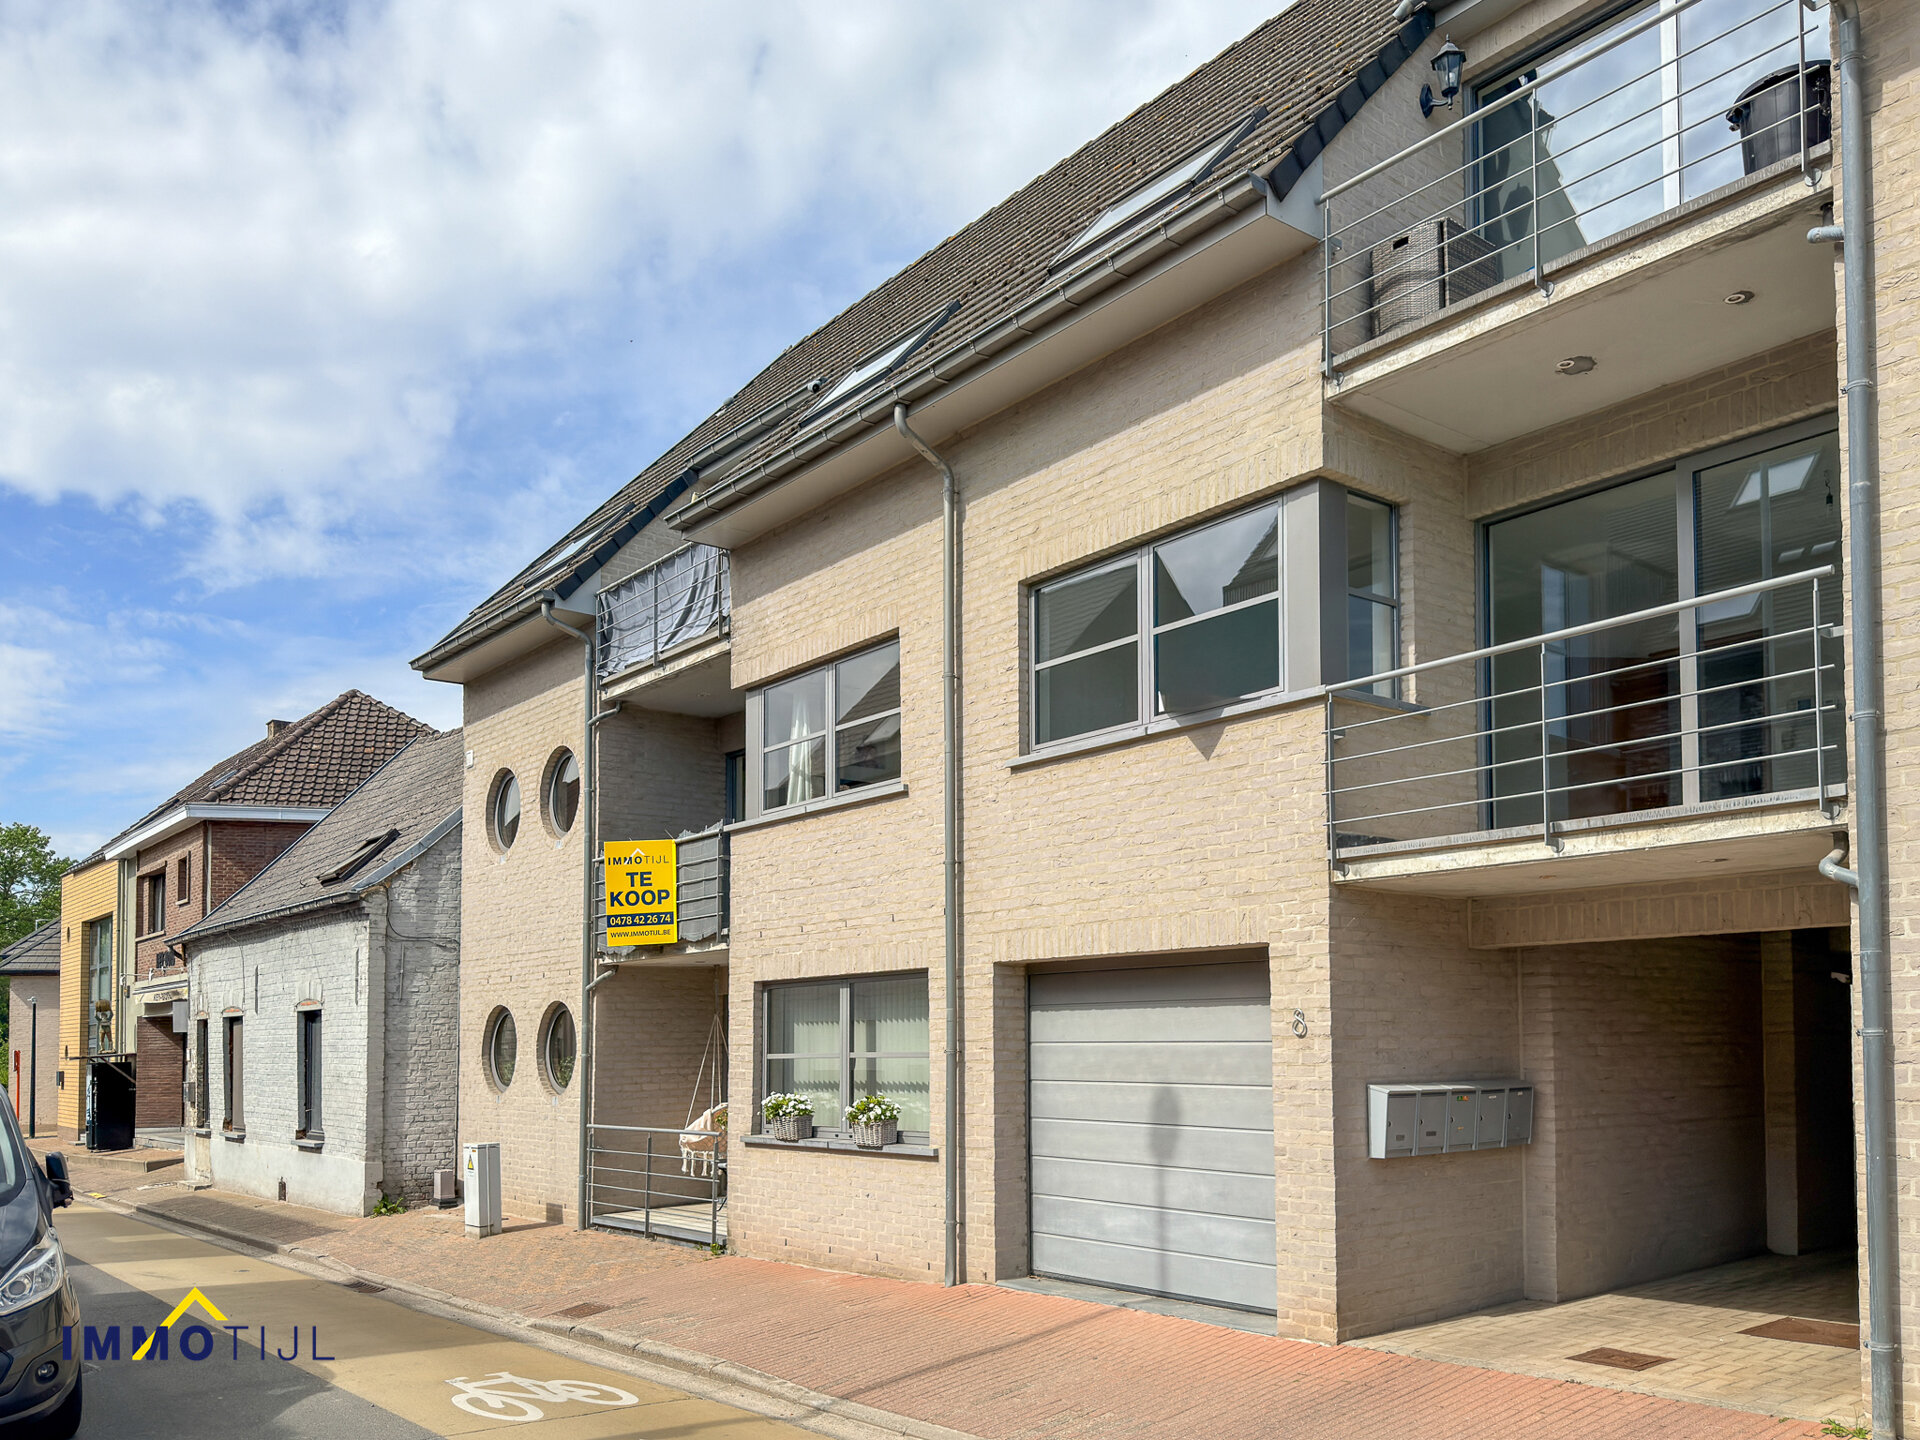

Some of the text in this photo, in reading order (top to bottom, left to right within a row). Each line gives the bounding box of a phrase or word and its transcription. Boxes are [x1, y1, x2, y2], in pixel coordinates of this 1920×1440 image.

[626, 871, 653, 887] TE
[609, 889, 670, 907] KOOP
[610, 914, 671, 926] 0478 42 26 74
[610, 929, 671, 938] WWW.IMMOTIJL.BE
[1292, 1008, 1307, 1038] 8
